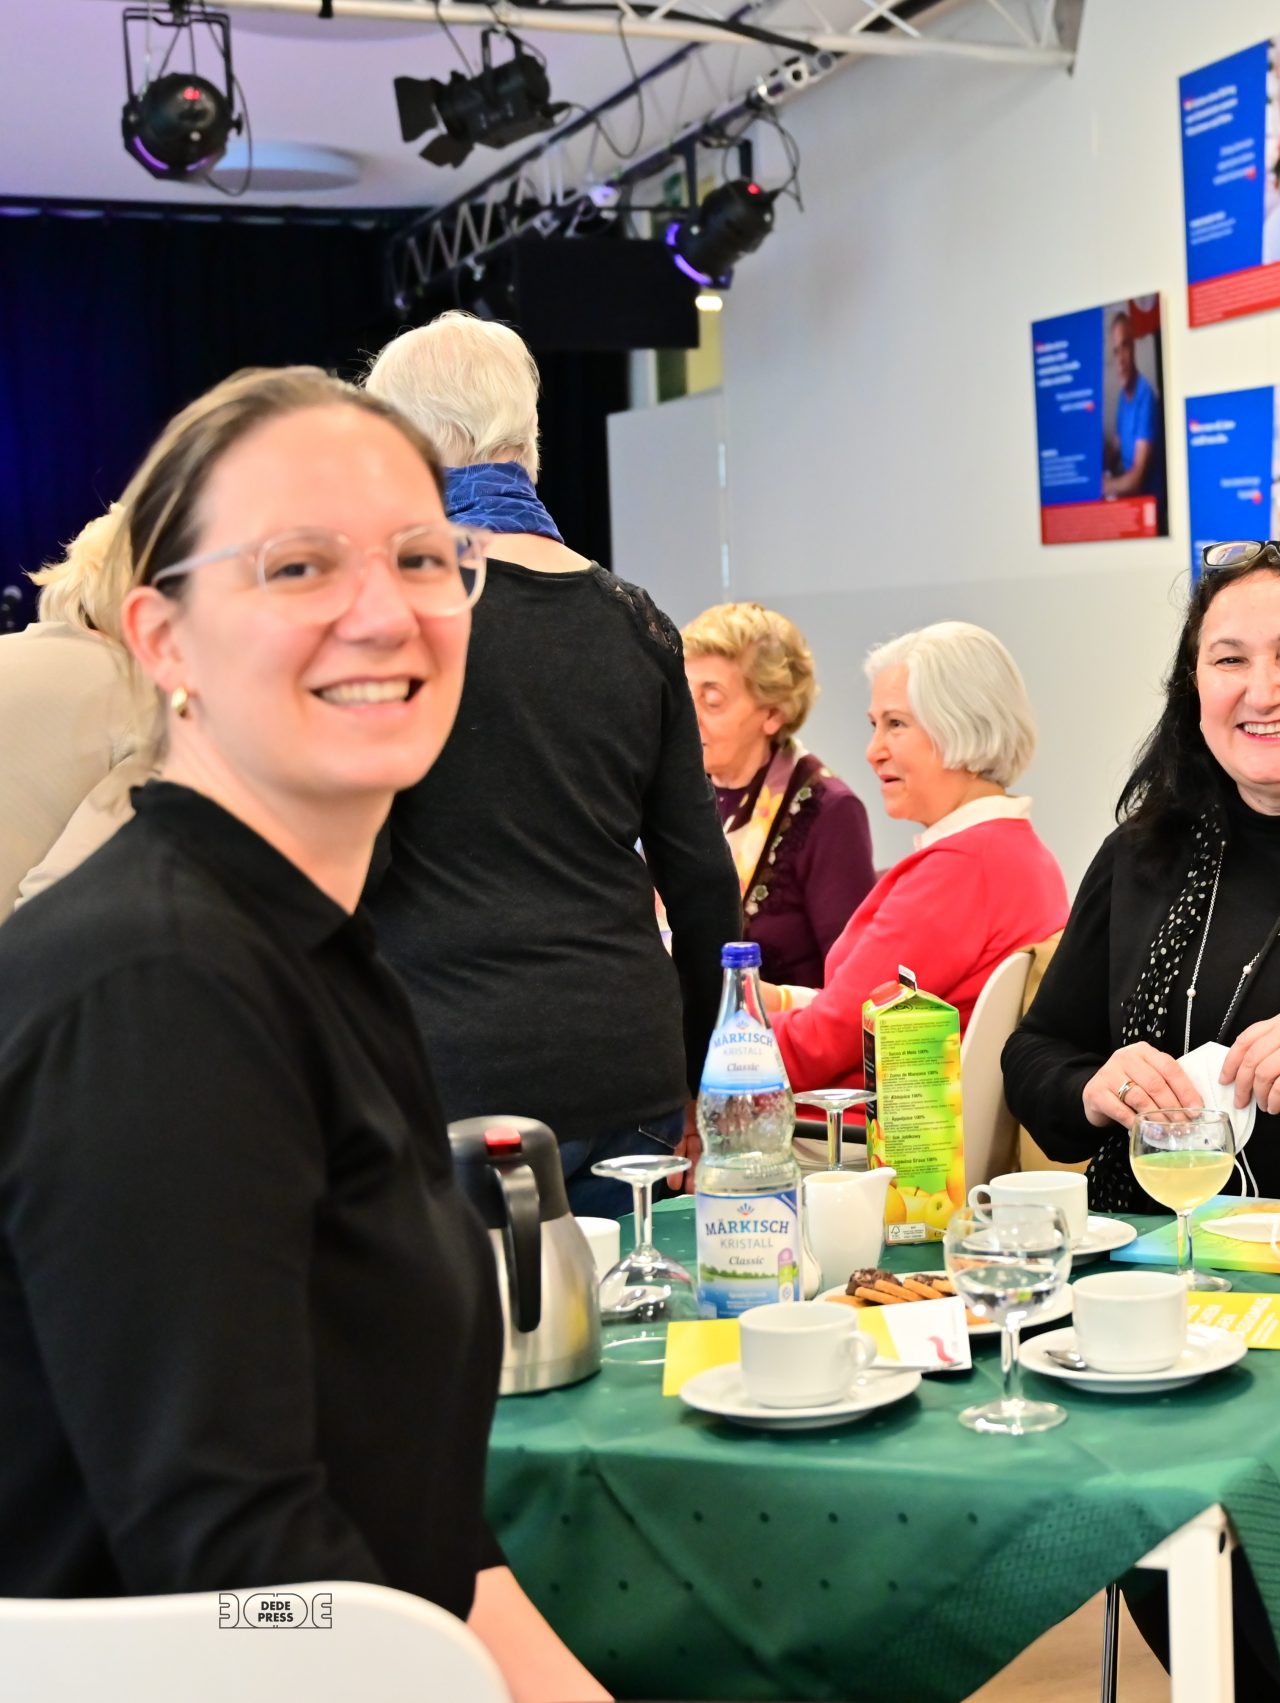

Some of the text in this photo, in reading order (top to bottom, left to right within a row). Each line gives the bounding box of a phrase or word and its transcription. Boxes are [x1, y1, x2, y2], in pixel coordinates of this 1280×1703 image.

[727, 1062, 760, 1072] Classic
[705, 1218, 789, 1236] MÄRKISCH
[720, 1238, 774, 1249] KRISTALL
[729, 1256, 764, 1266] Classic
